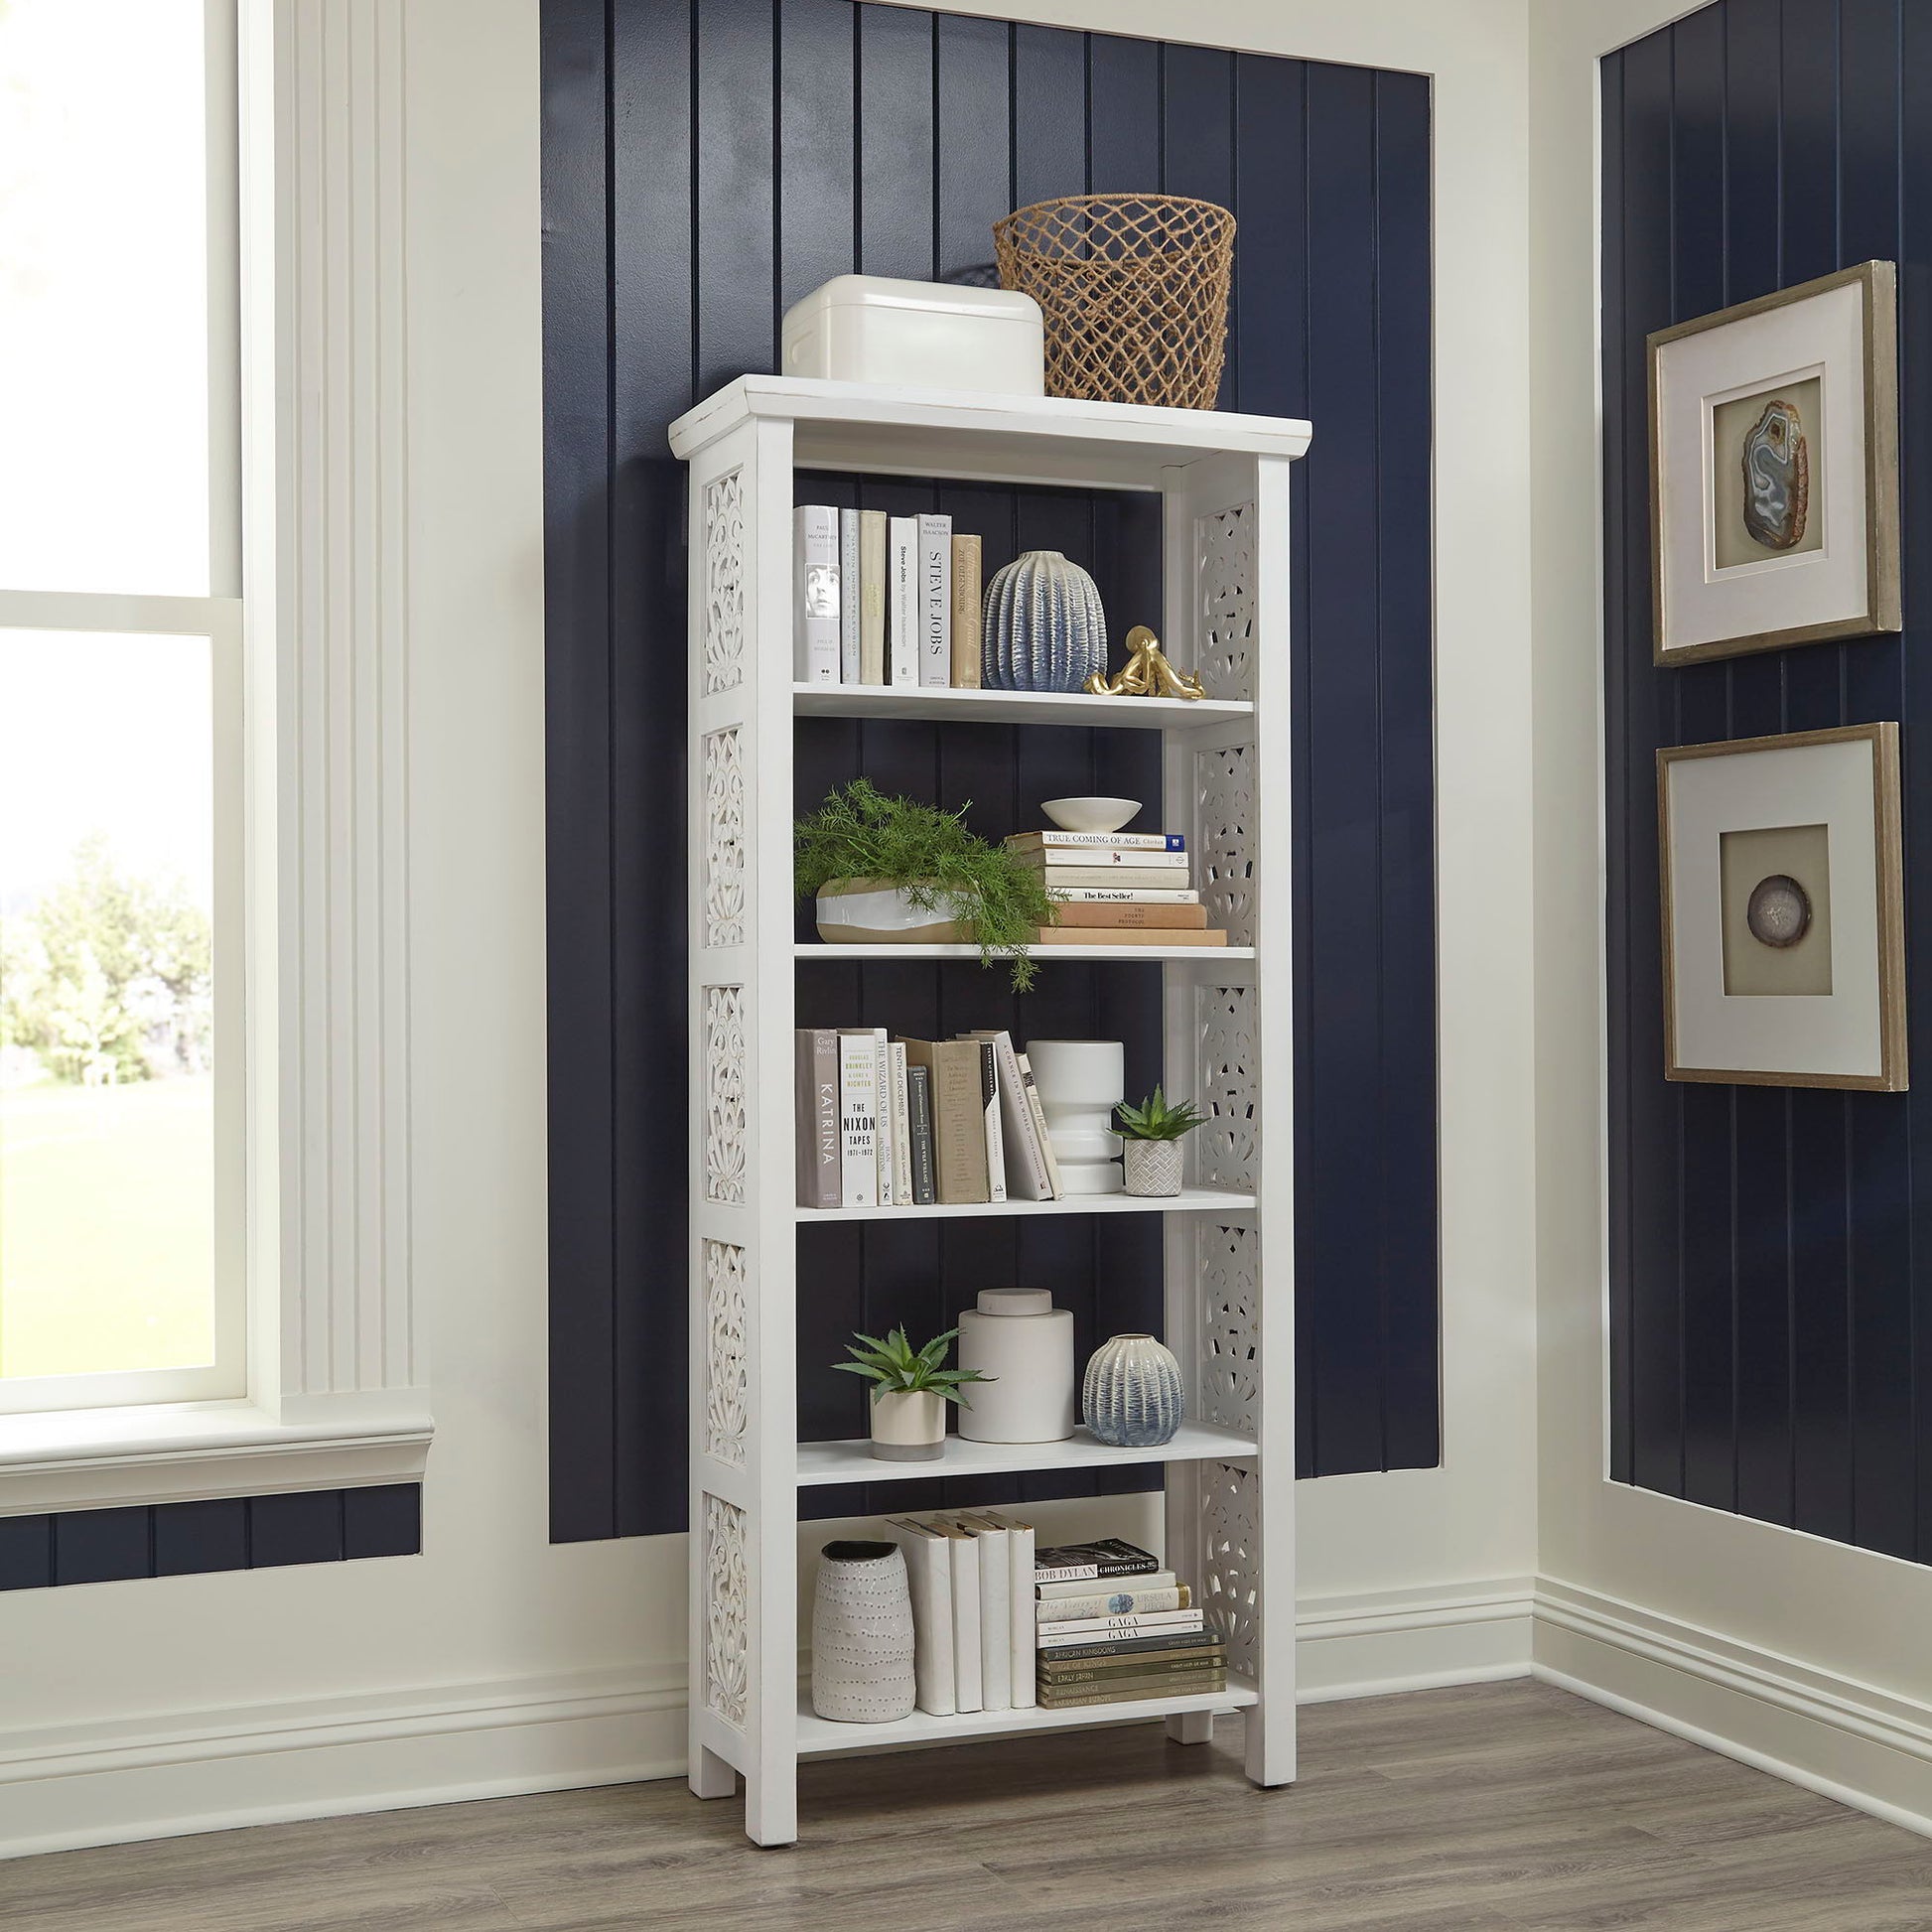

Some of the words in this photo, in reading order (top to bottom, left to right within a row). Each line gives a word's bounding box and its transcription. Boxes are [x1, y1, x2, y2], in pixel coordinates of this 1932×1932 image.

[930, 551, 942, 608] STEVE
[930, 614, 943, 655] JOBS
[1072, 834, 1109, 844] COMING
[817, 1036, 835, 1046] Gary
[879, 1059, 888, 1099] WIZARD
[1005, 1051, 1017, 1078] CHANCE
[1022, 1108, 1032, 1132] WORLD
[853, 1103, 865, 1112] THE
[880, 1100, 888, 1113] OF
[820, 1083, 835, 1165] KATRINA
[843, 1117, 876, 1131] NIXON
[880, 1116, 889, 1128] US
[849, 1136, 871, 1145] TAPES
[1035, 1569, 1056, 1581] BOB
[1059, 1566, 1096, 1579] DYLAN
[1099, 1564, 1146, 1575] CHRONICLES
[1137, 1591, 1172, 1602] URSULA
[1108, 1616, 1139, 1627] GAGA
[1108, 1628, 1139, 1639] GAGA
[1082, 1646, 1116, 1656] KINGDOMS
